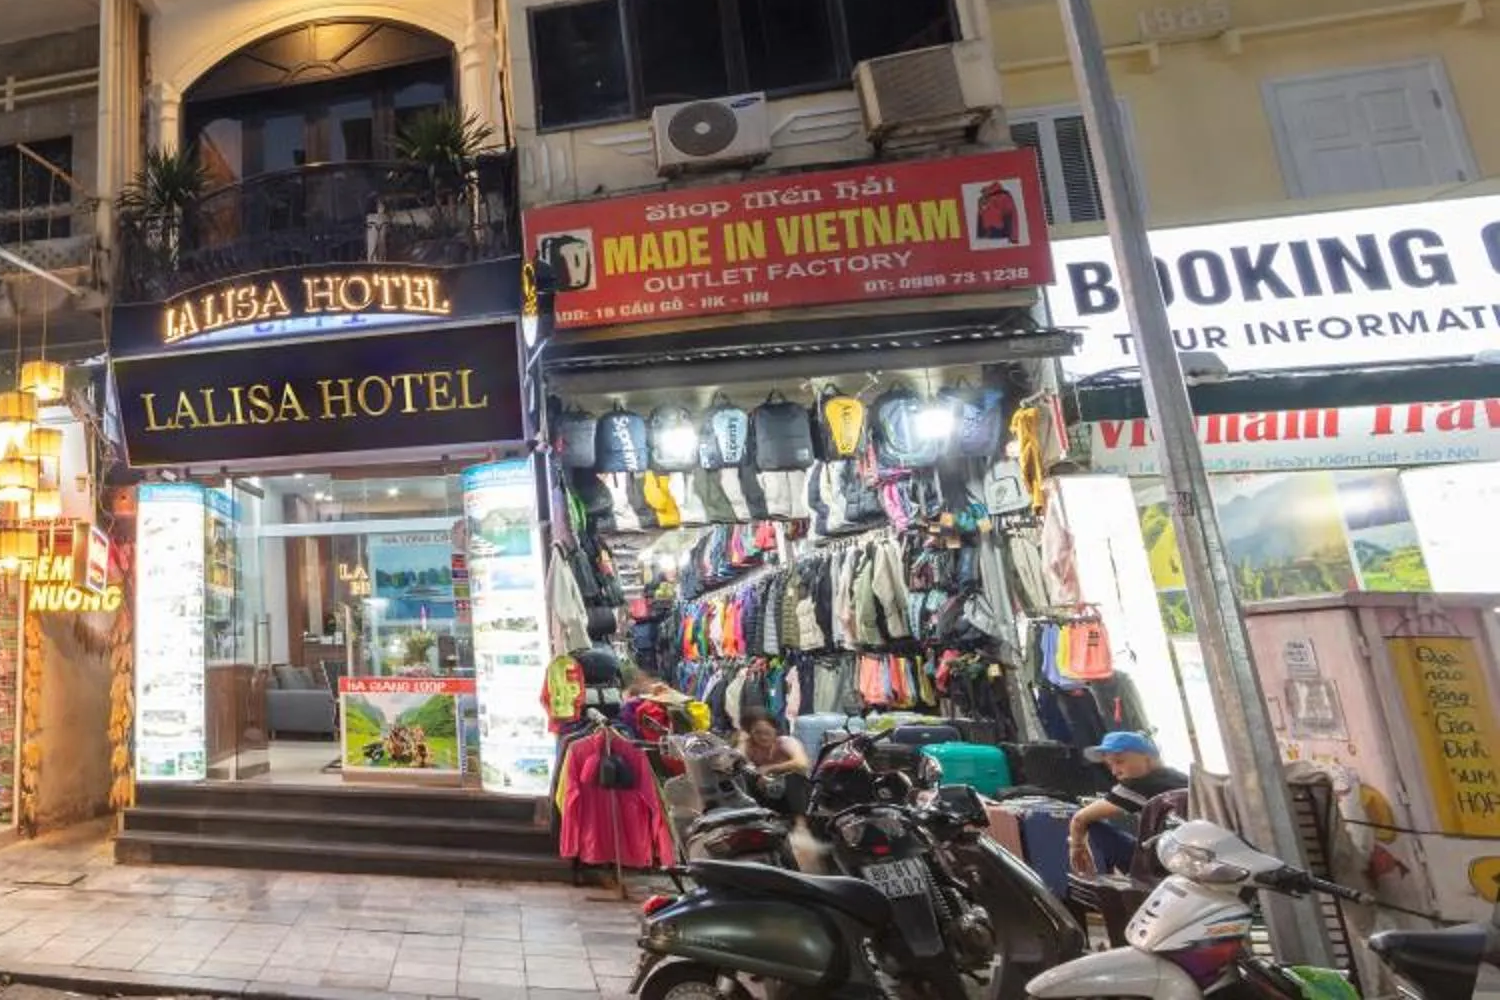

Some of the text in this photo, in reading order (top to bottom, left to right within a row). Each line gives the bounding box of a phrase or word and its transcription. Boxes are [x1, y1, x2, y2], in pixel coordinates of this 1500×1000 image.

[603, 199, 961, 276] MADE IN VIETNAM
[644, 250, 913, 293] OUTLET FACTORY
[162, 272, 452, 344] LALISA HOTEL
[1113, 326, 1229, 355] TUR
[140, 368, 489, 433] LALISA HOTEL
